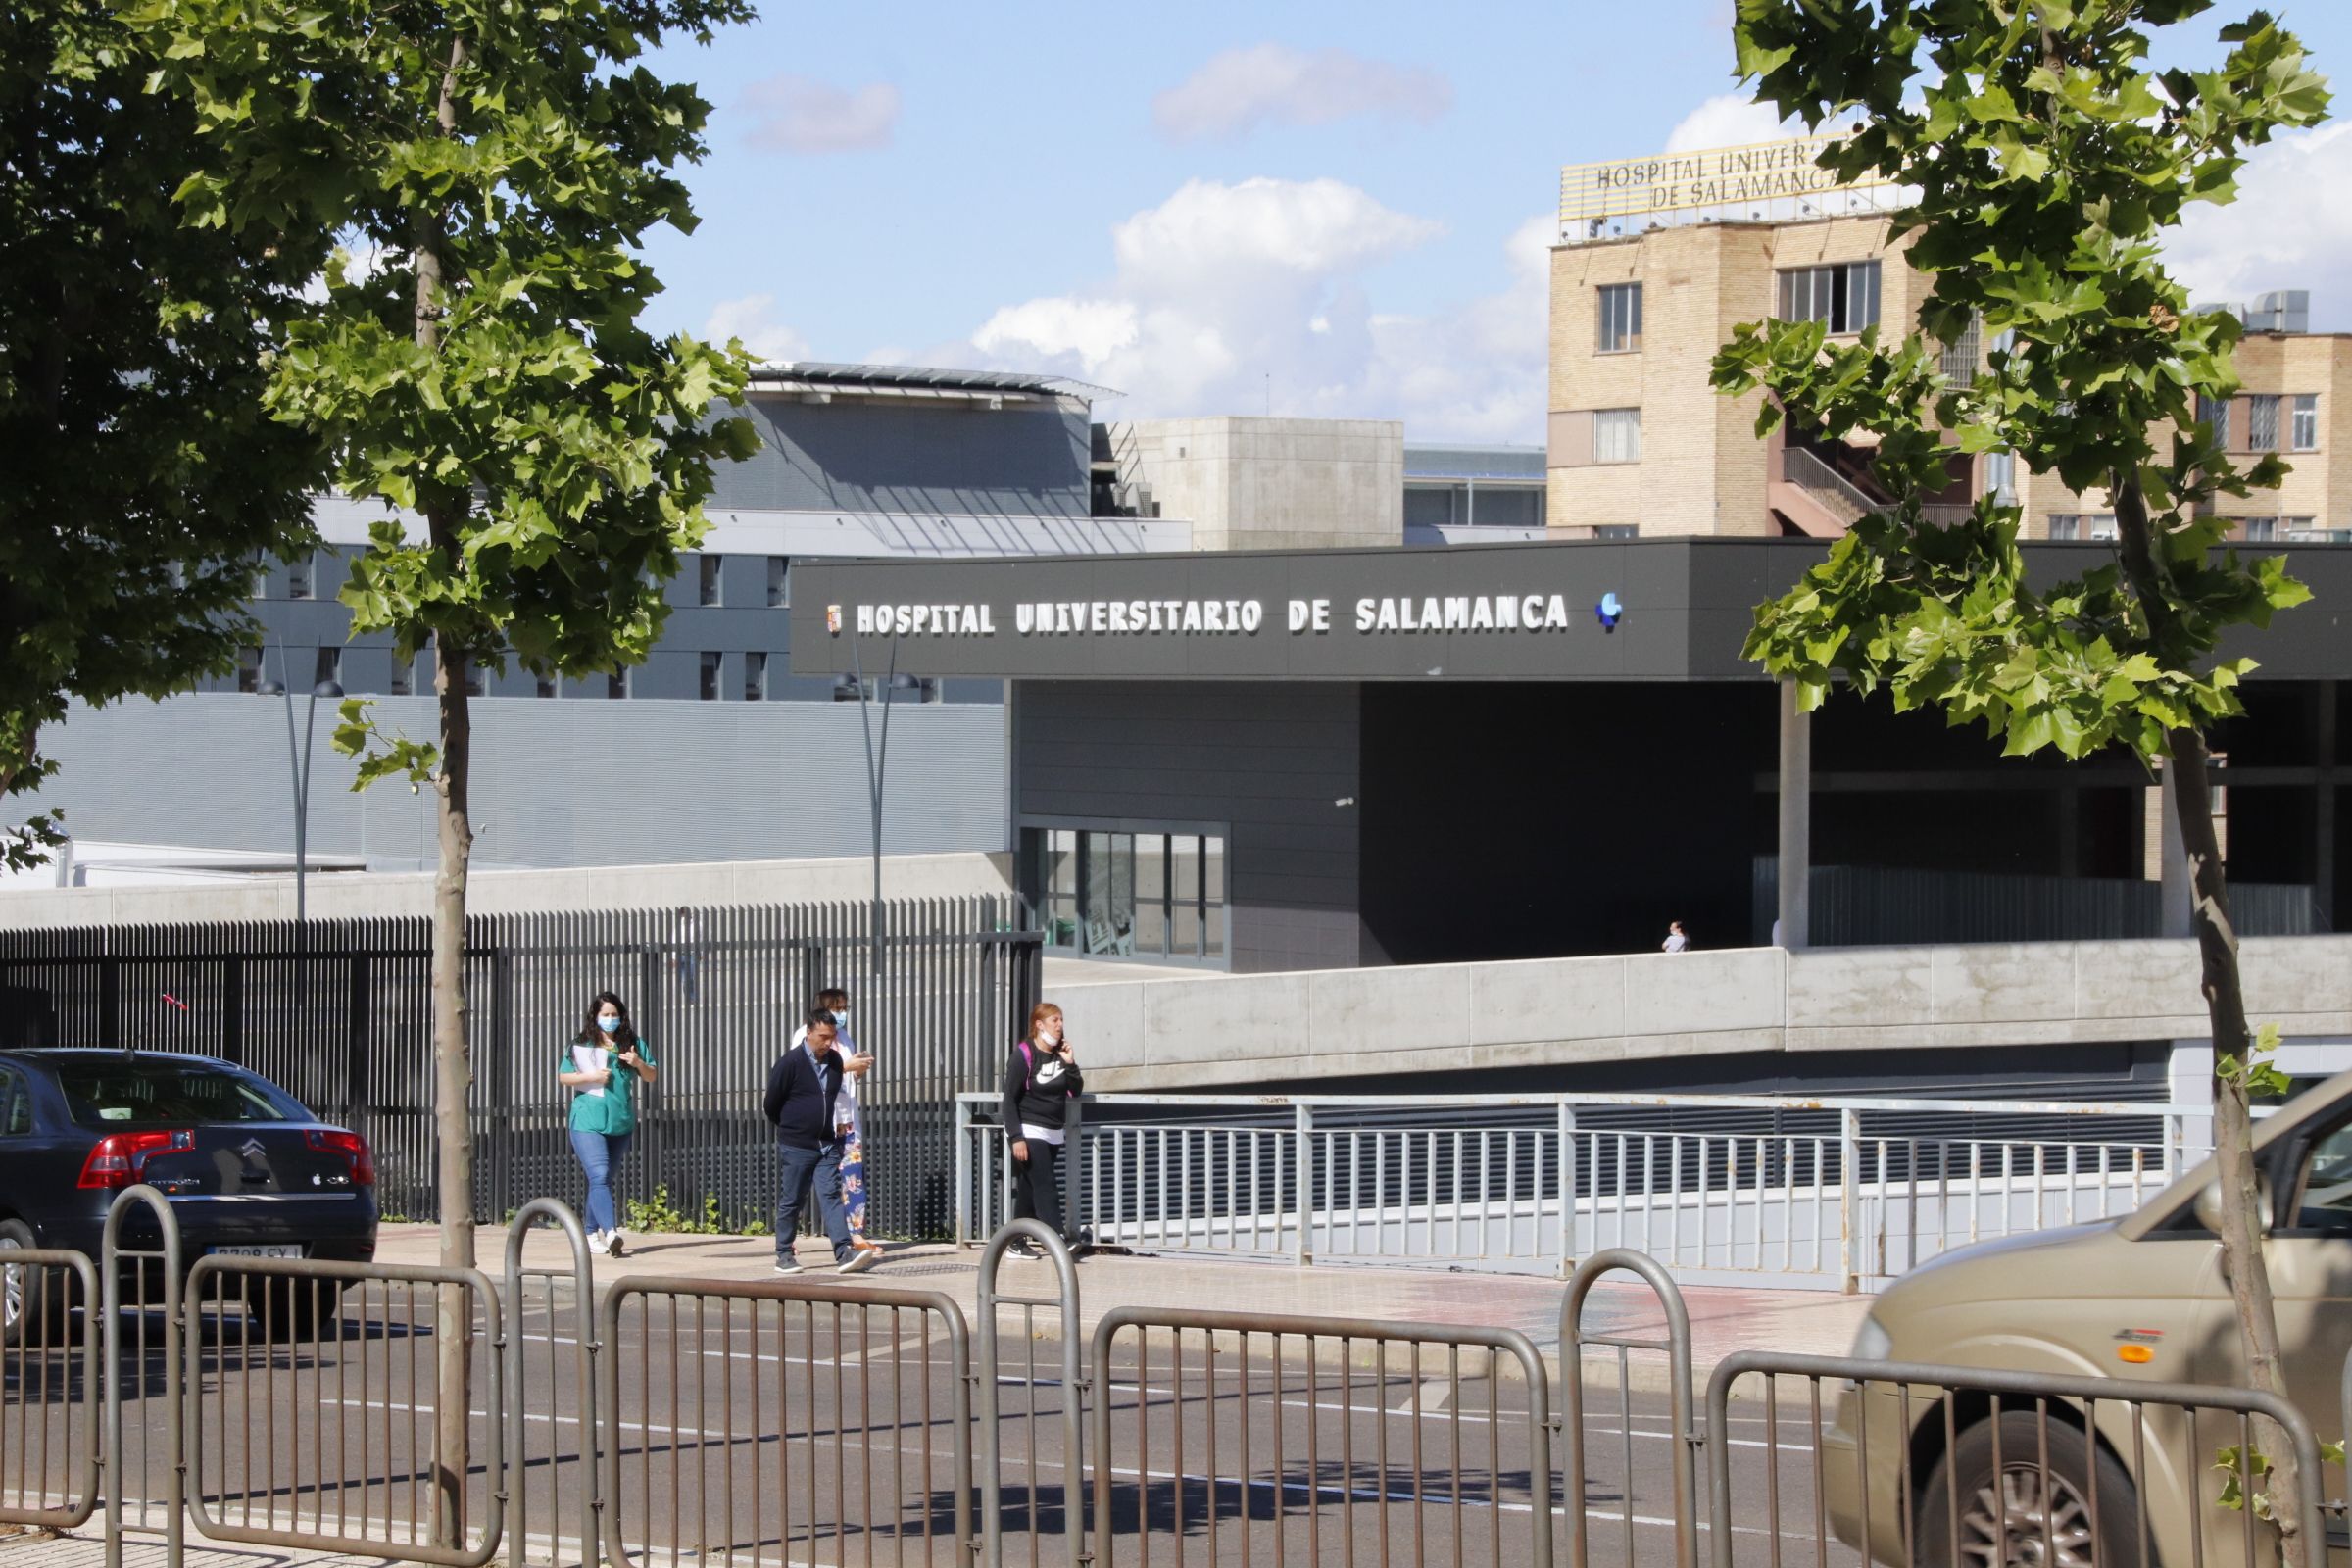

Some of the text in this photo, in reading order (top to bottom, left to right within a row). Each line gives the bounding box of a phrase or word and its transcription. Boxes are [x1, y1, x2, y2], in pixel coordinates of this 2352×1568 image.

[1597, 155, 1707, 189] HOSPITAL
[1652, 185, 1679, 208] DE
[857, 594, 1568, 635] HOSPITAL UNIVERSITARIO DE SALAMANCA
